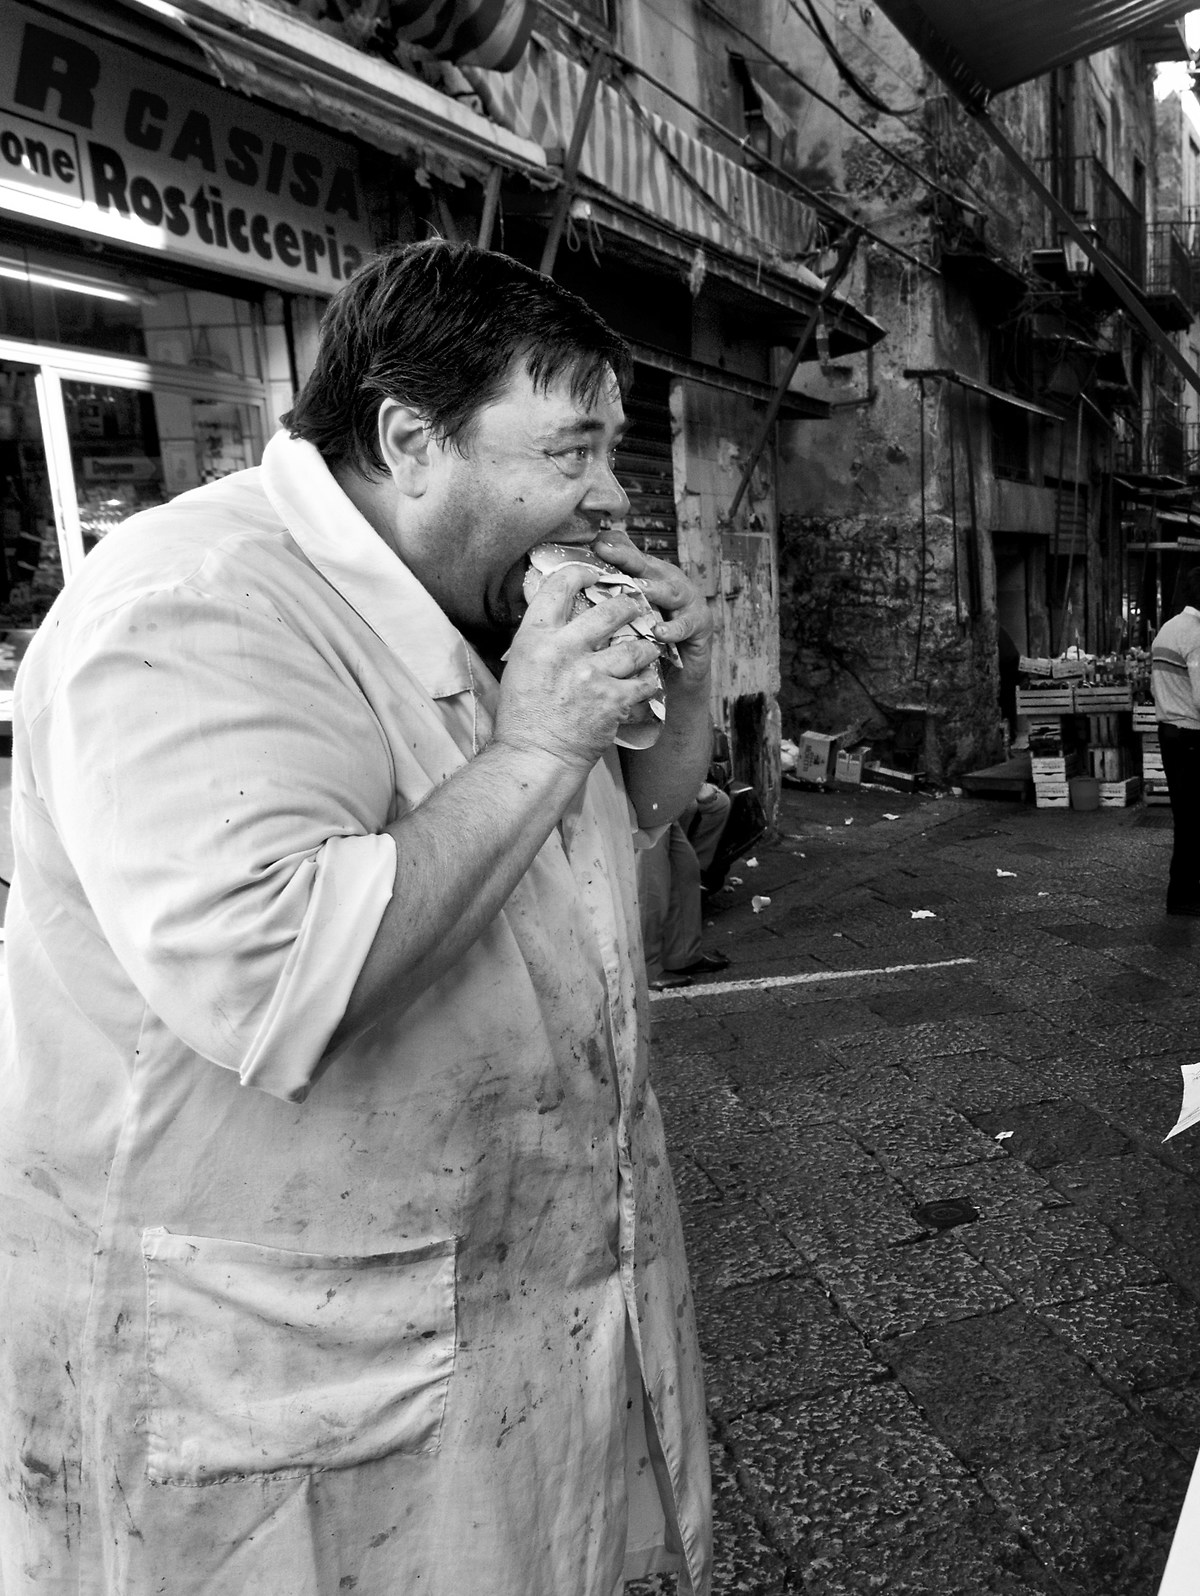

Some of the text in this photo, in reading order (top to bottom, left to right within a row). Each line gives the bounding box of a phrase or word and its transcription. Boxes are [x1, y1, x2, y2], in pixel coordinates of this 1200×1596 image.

[1, 131, 363, 280] one Rosticceria
[14, 23, 359, 222] R CASISA
